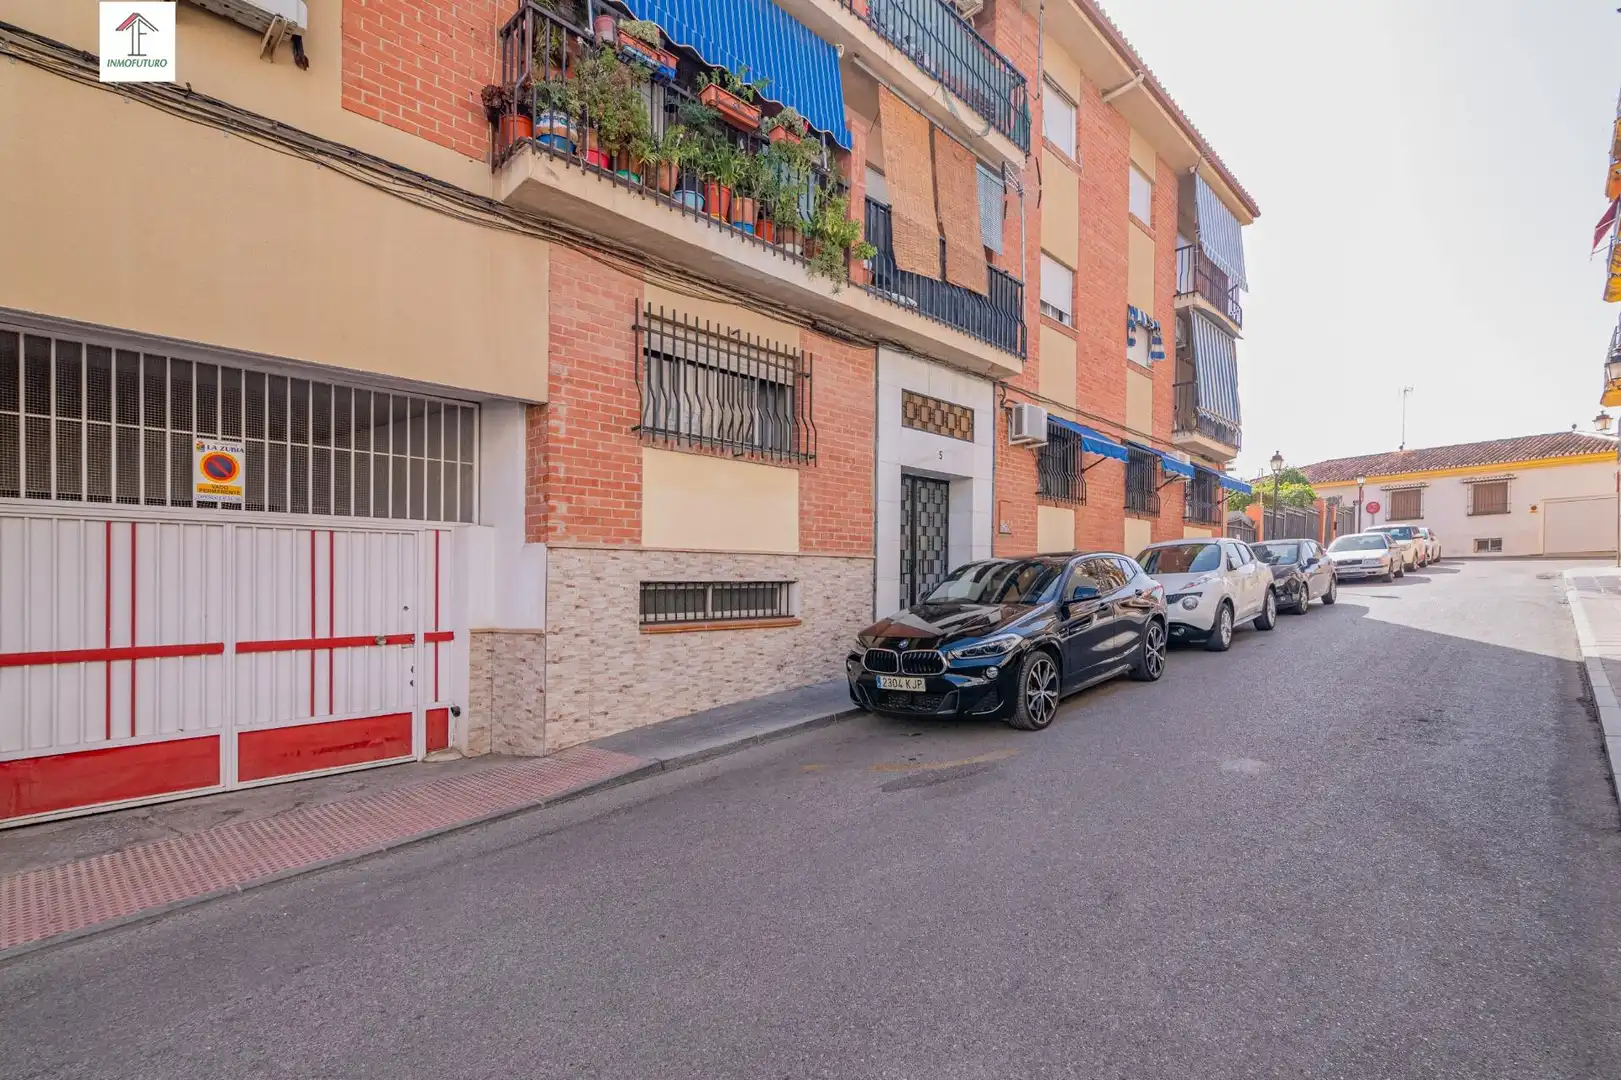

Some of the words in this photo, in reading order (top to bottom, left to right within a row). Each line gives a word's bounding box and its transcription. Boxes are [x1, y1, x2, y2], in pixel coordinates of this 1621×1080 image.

[939, 450, 943, 460] 5
[198, 487, 241, 496] PERMANENTE
[883, 677, 903, 688] 2304
[905, 679, 923, 690] KJP
